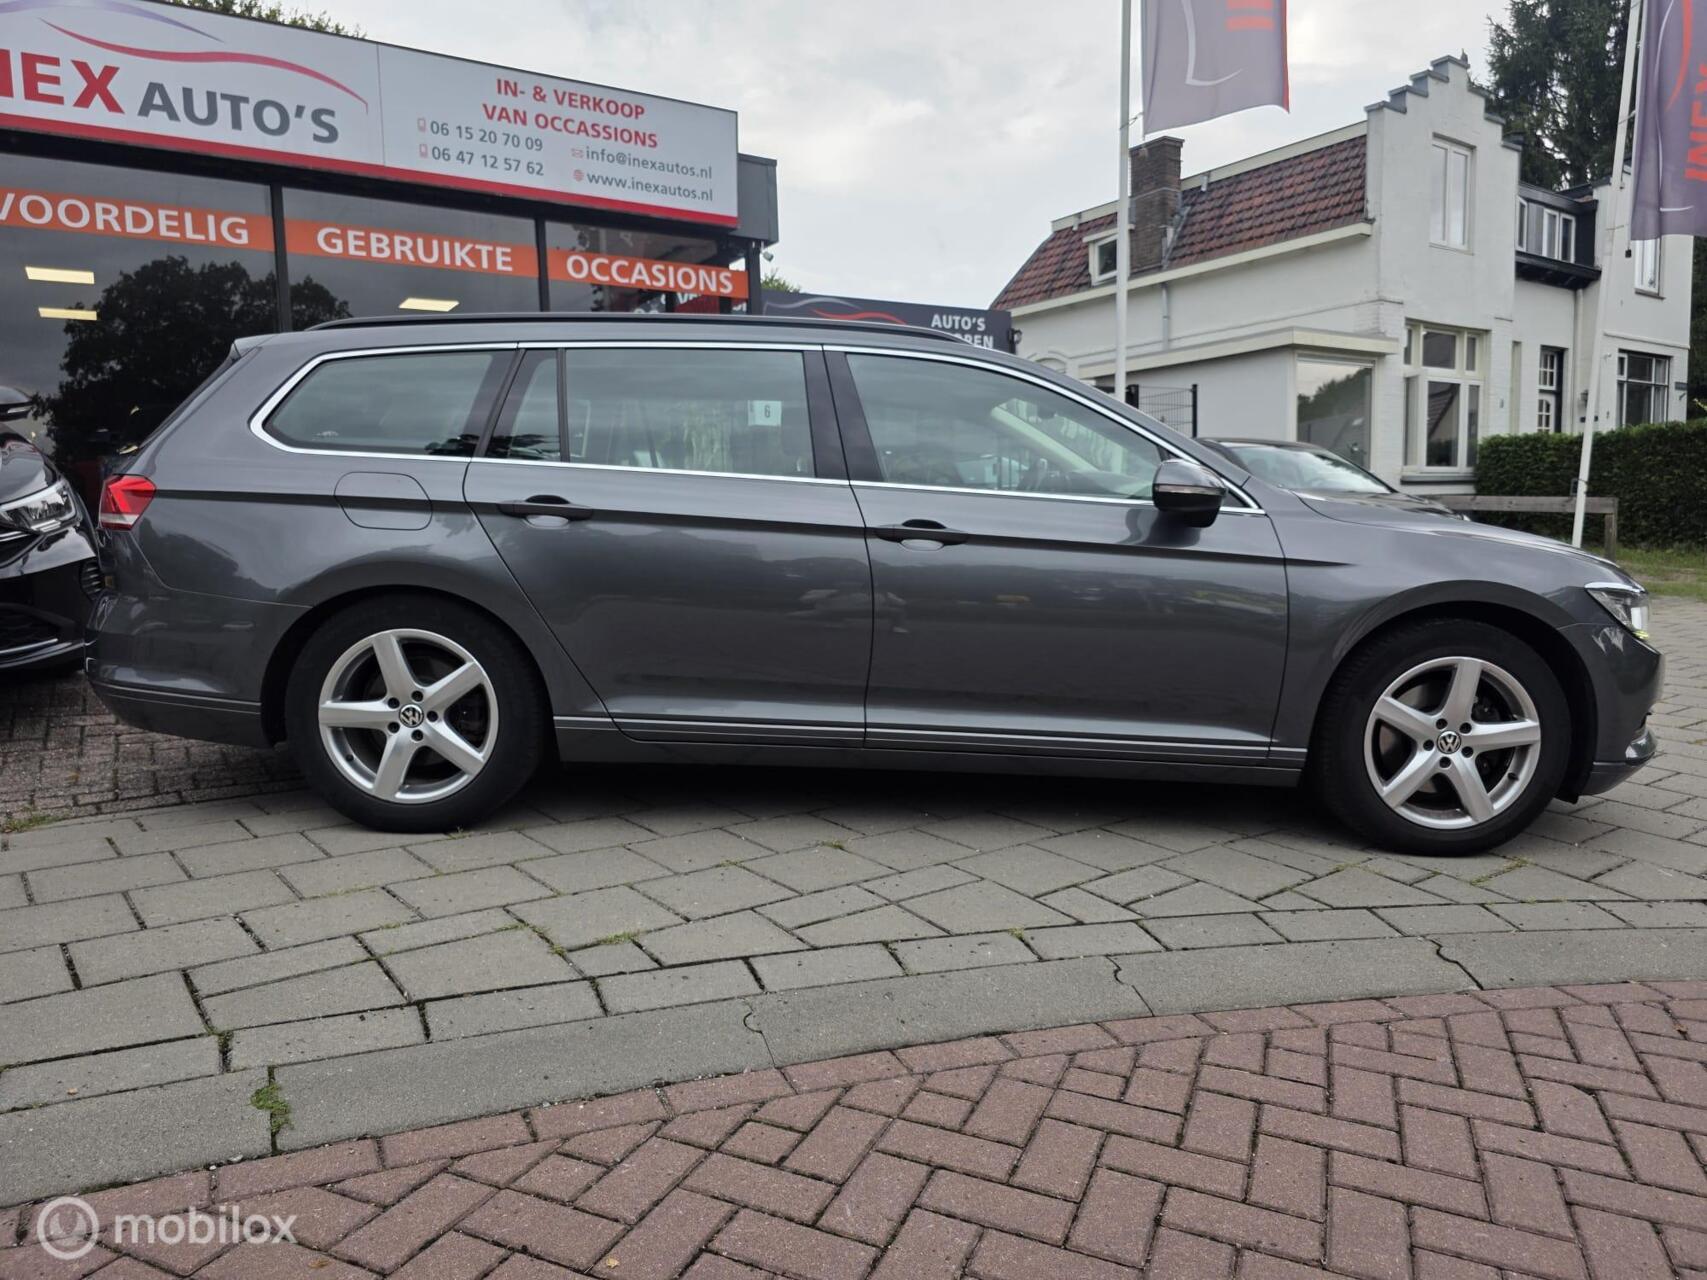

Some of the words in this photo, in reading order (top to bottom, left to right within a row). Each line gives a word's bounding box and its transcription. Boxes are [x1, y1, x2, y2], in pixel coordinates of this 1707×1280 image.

[137, 81, 339, 144] AUTO'S
[496, 78, 525, 97] IN-
[532, 86, 547, 103] &
[553, 89, 645, 120] VERKOOP
[430, 120, 449, 136] 06
[456, 125, 474, 140] 15
[479, 129, 497, 144] 20
[502, 132, 520, 148] 70
[525, 137, 543, 151] 09
[482, 103, 527, 126] VAN
[534, 113, 658, 148] OCCASSIONS
[432, 146, 451, 161] 06
[456, 150, 474, 165] 47
[481, 154, 498, 169] 12
[504, 157, 521, 172] 57
[526, 161, 544, 176] 62
[586, 146, 712, 179] info@inexautos.nl
[587, 173, 713, 201] www.inexautos.nl
[317, 227, 513, 272] GEBRUIKTE
[566, 254, 733, 294] OCCASIONS
[931, 314, 986, 331] AUTO'S
